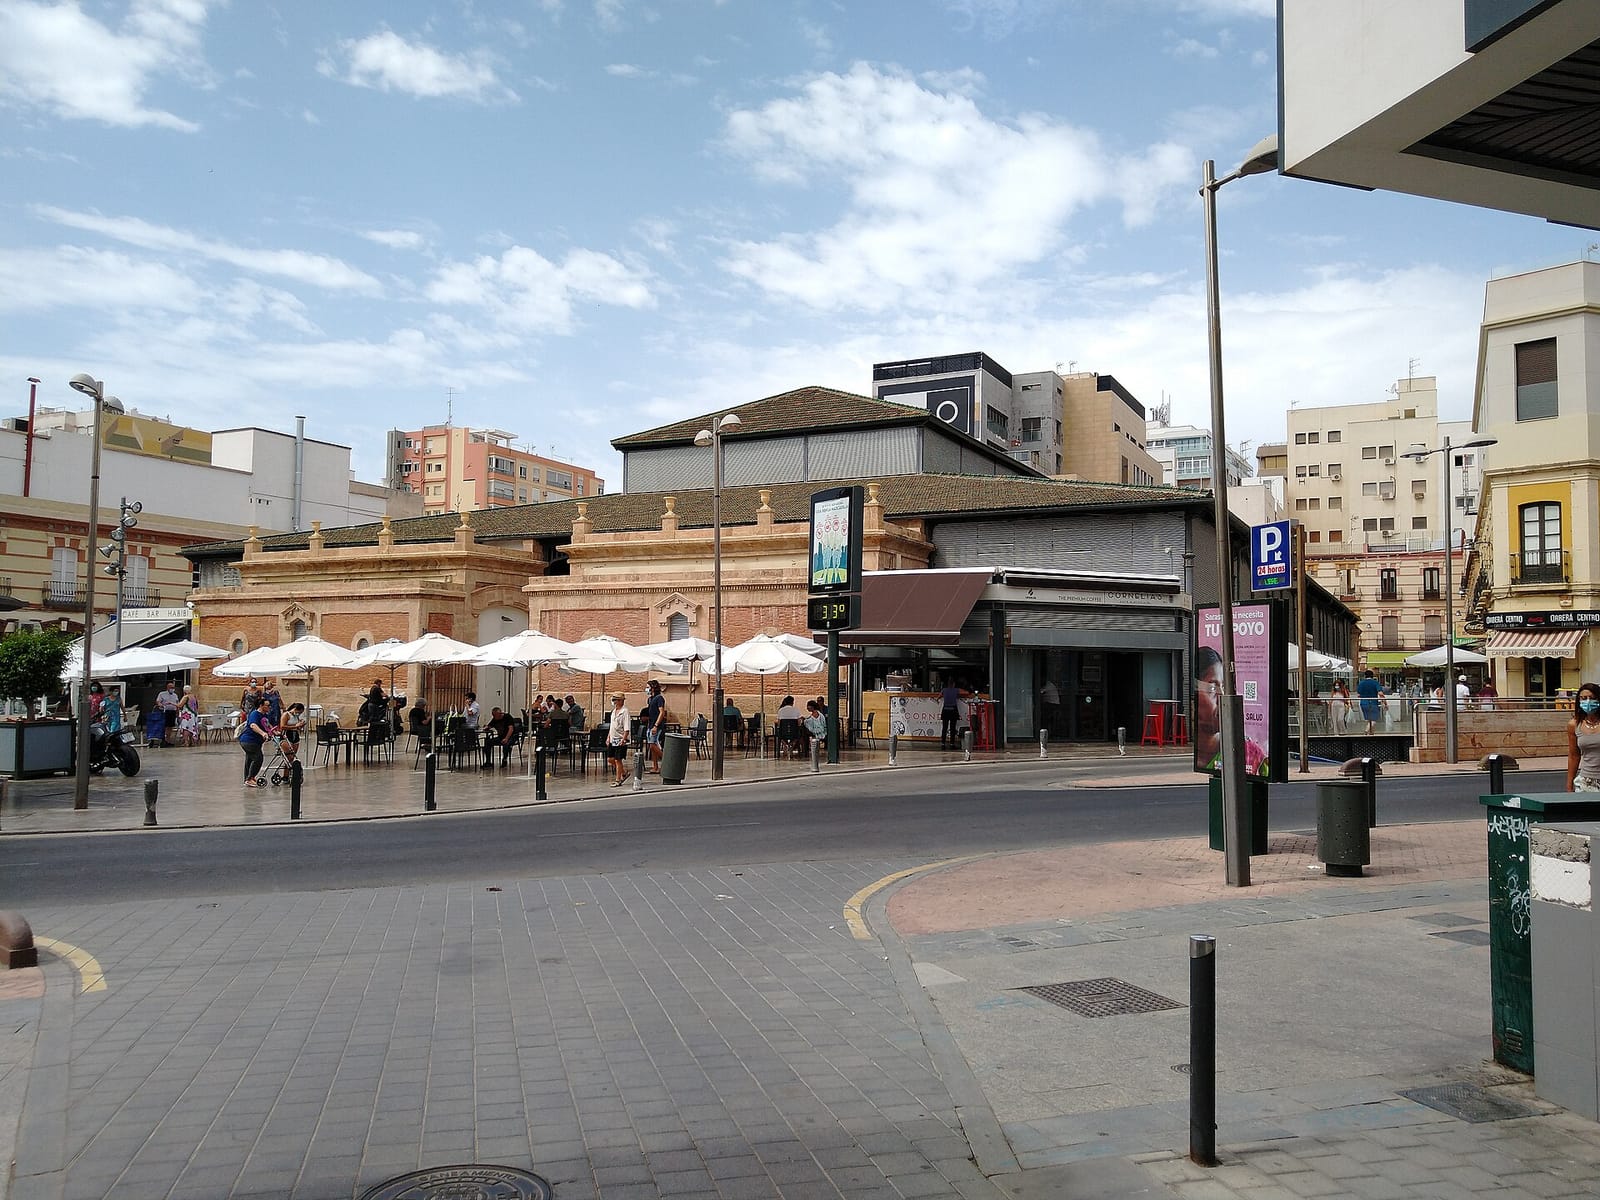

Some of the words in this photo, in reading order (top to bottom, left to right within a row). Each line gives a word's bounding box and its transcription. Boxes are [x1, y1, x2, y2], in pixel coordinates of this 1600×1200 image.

[1260, 526, 1282, 563] P
[1258, 566, 1266, 574] 24
[1268, 564, 1285, 573] horas
[167, 609, 189, 617] HABIBI
[1238, 610, 1264, 619] necesita
[1576, 613, 1600, 621] CENTRO
[1205, 623, 1220, 637] TU
[1233, 621, 1265, 636] POYO
[1245, 713, 1263, 721] SALUD
